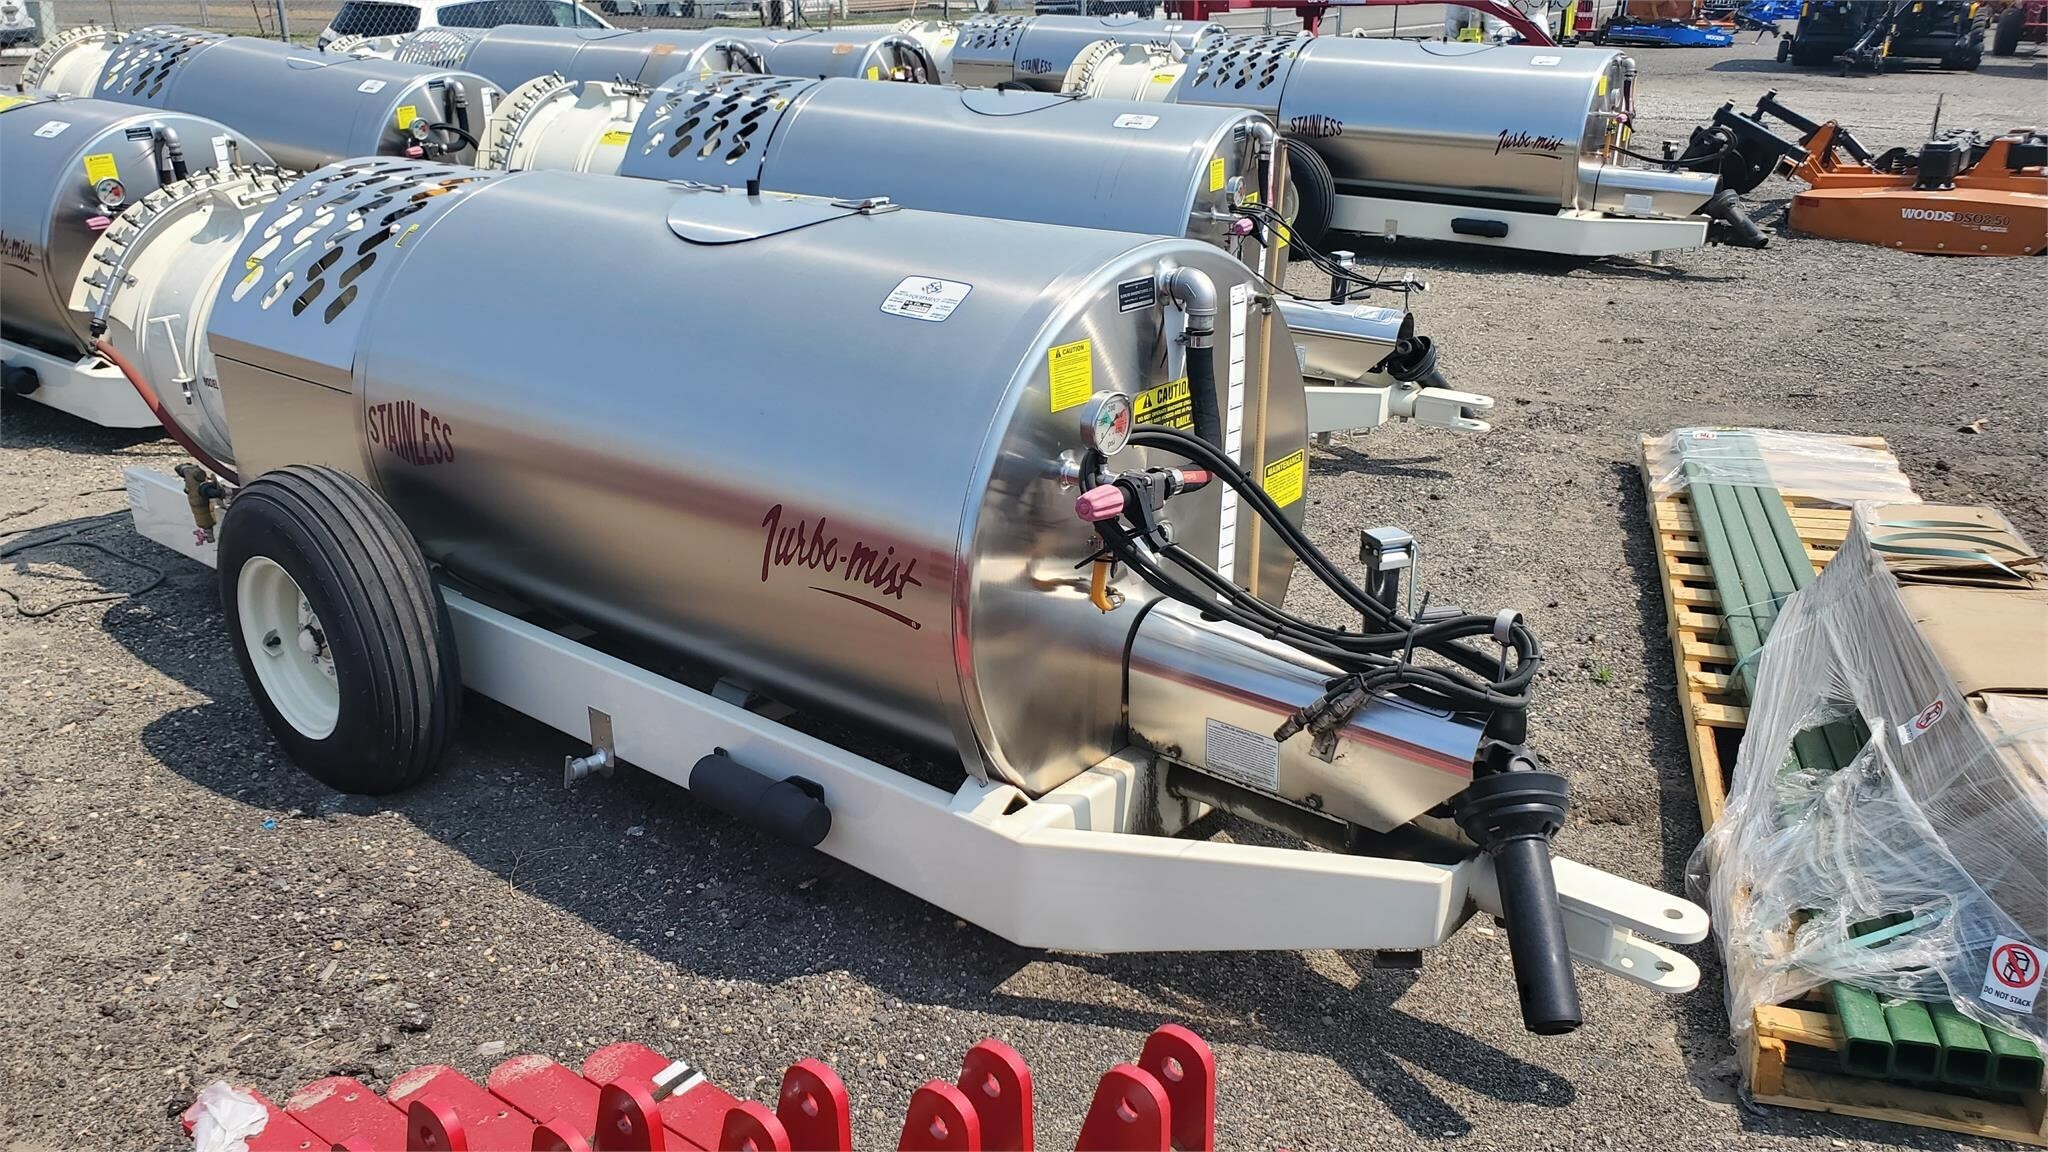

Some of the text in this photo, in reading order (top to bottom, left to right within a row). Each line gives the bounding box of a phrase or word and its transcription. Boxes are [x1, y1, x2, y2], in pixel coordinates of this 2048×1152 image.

[1290, 114, 1343, 138] STAINLESS
[1901, 207, 1954, 222] WOODS
[1062, 344, 1085, 356] CAUTION
[1157, 380, 1190, 405] CAUTIO
[368, 400, 454, 466] STAINLESS
[1267, 453, 1302, 477] MAINTENANCE
[761, 503, 922, 600] Turbo-mist
[1983, 985, 2032, 1007] DO NOT STACK
